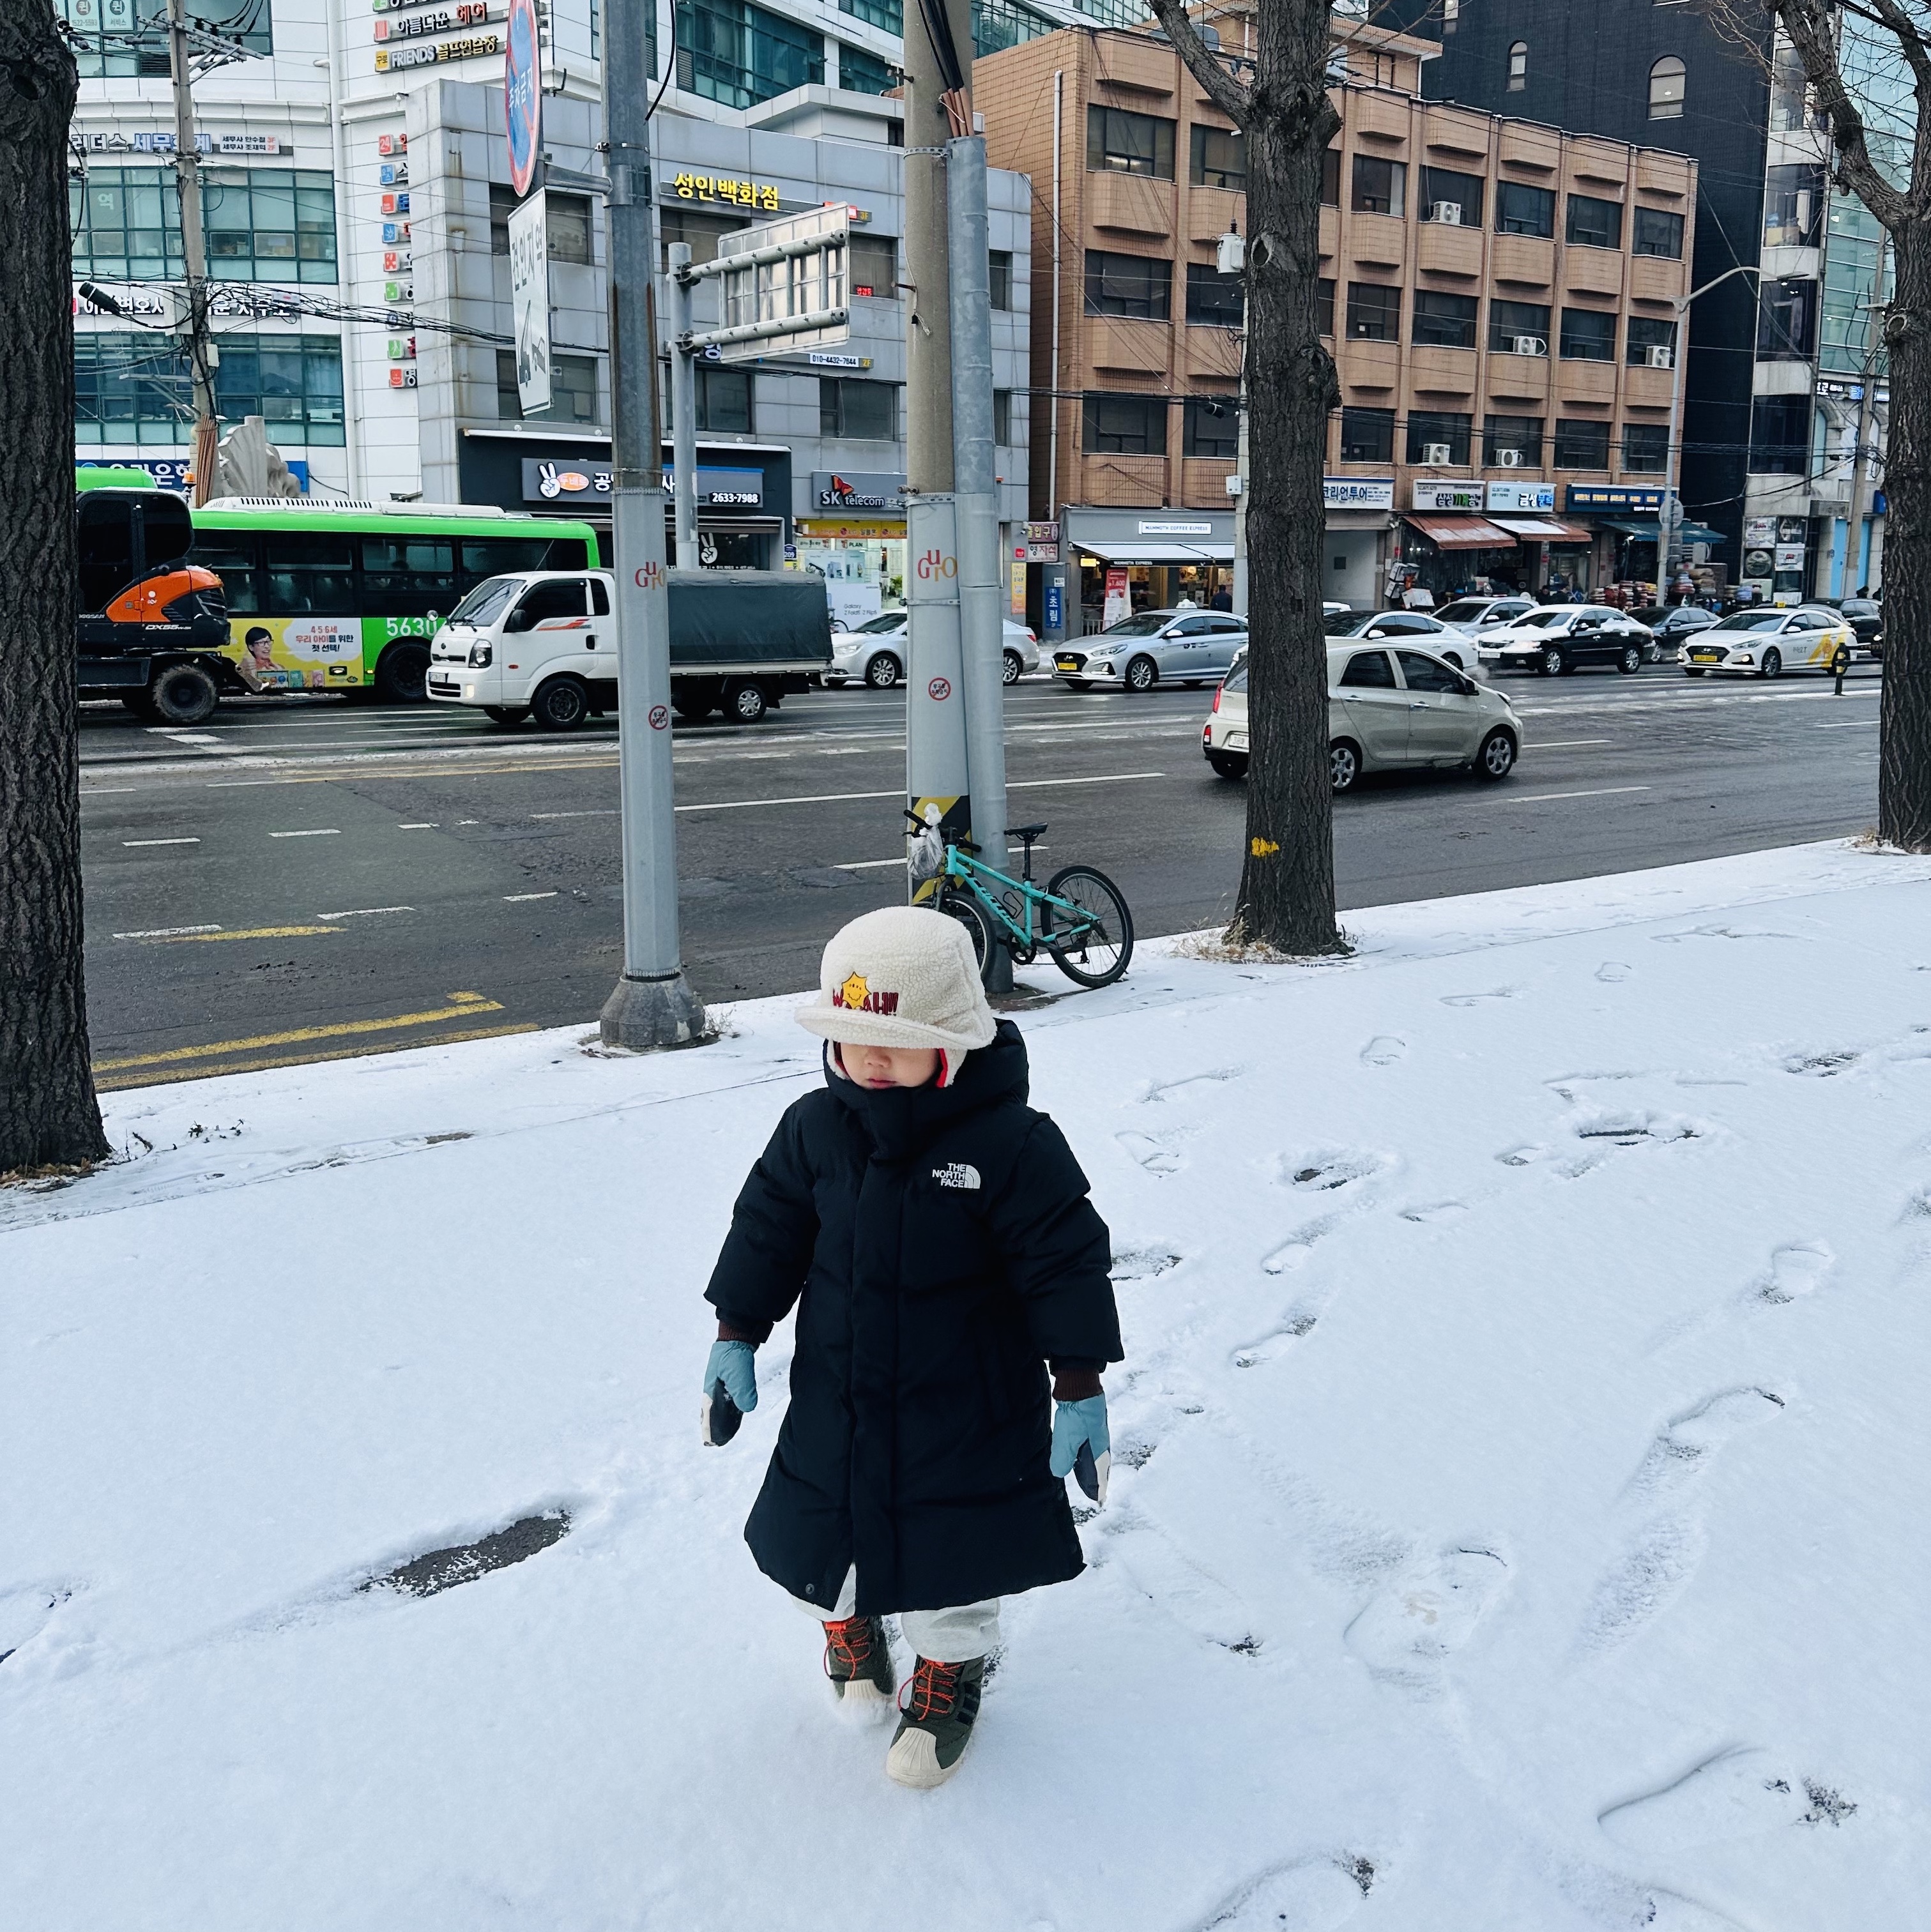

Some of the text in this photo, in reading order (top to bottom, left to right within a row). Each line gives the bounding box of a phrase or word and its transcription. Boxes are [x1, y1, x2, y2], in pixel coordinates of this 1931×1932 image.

[398, 2, 487, 35] 아름다운 헤어
[392, 34, 498, 67] FRIENDS 골프연습장
[509, 62, 533, 118] 주차금지
[134, 133, 213, 153] 세무계
[674, 172, 779, 210] 성인백화점
[512, 217, 543, 292] 견인지역
[712, 492, 758, 503] 2633-7988
[821, 491, 841, 505] SK
[844, 494, 885, 506] telecom
[932, 1169, 965, 1180] NORTH
[947, 1162, 966, 1172] THE
[940, 1178, 965, 1188] FACE
